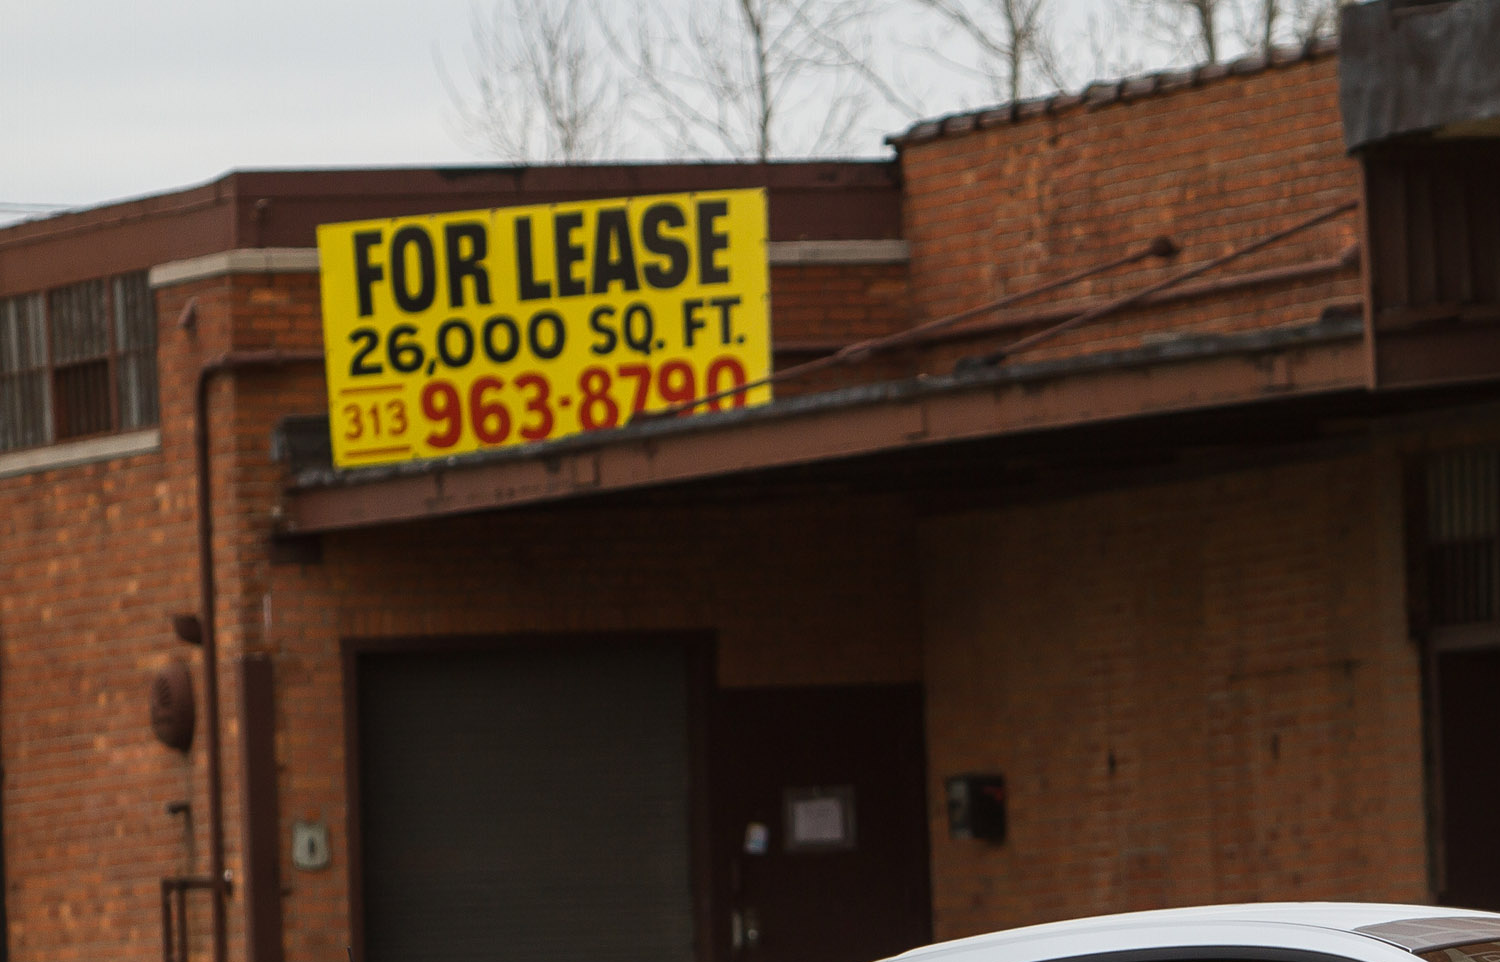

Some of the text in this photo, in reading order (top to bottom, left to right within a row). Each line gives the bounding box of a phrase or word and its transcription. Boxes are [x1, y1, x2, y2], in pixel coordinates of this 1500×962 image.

[352, 200, 730, 318] FOR LEASE
[348, 296, 746, 377] 26,000 SQ. FT.
[343, 399, 408, 441] 313
